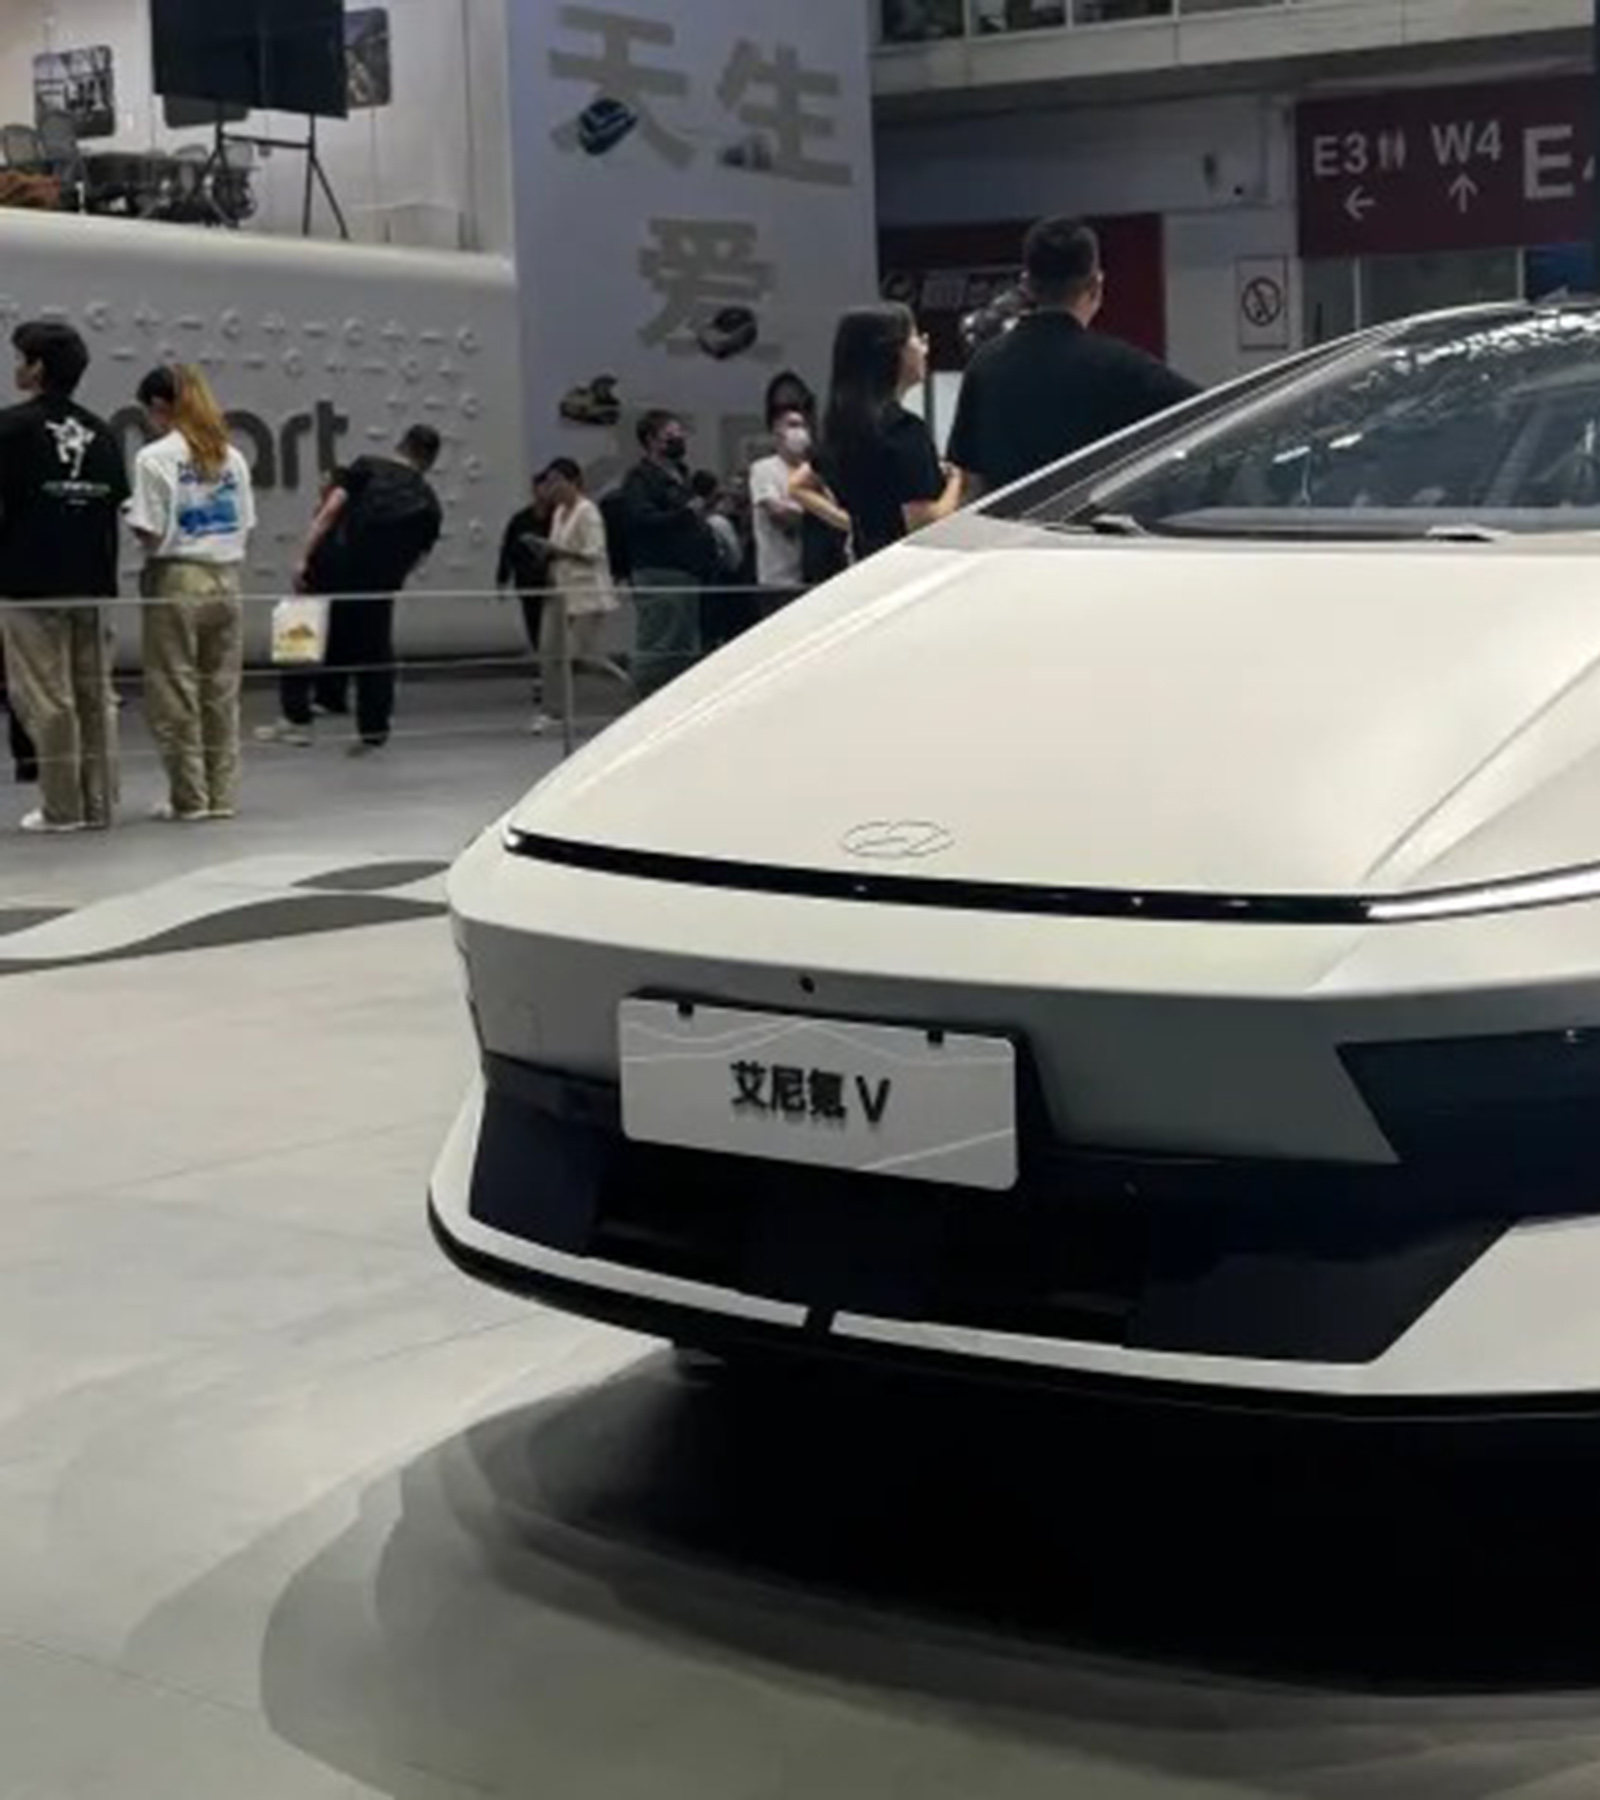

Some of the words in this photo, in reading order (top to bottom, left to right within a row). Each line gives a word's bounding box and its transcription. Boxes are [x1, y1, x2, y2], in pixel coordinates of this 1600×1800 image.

[549, 5, 853, 187] 天生
[1312, 132, 1369, 176] E3
[1430, 120, 1501, 165] W4
[1523, 124, 1595, 200] E
[636, 217, 784, 360] 爱
[856, 1075, 891, 1122] V
